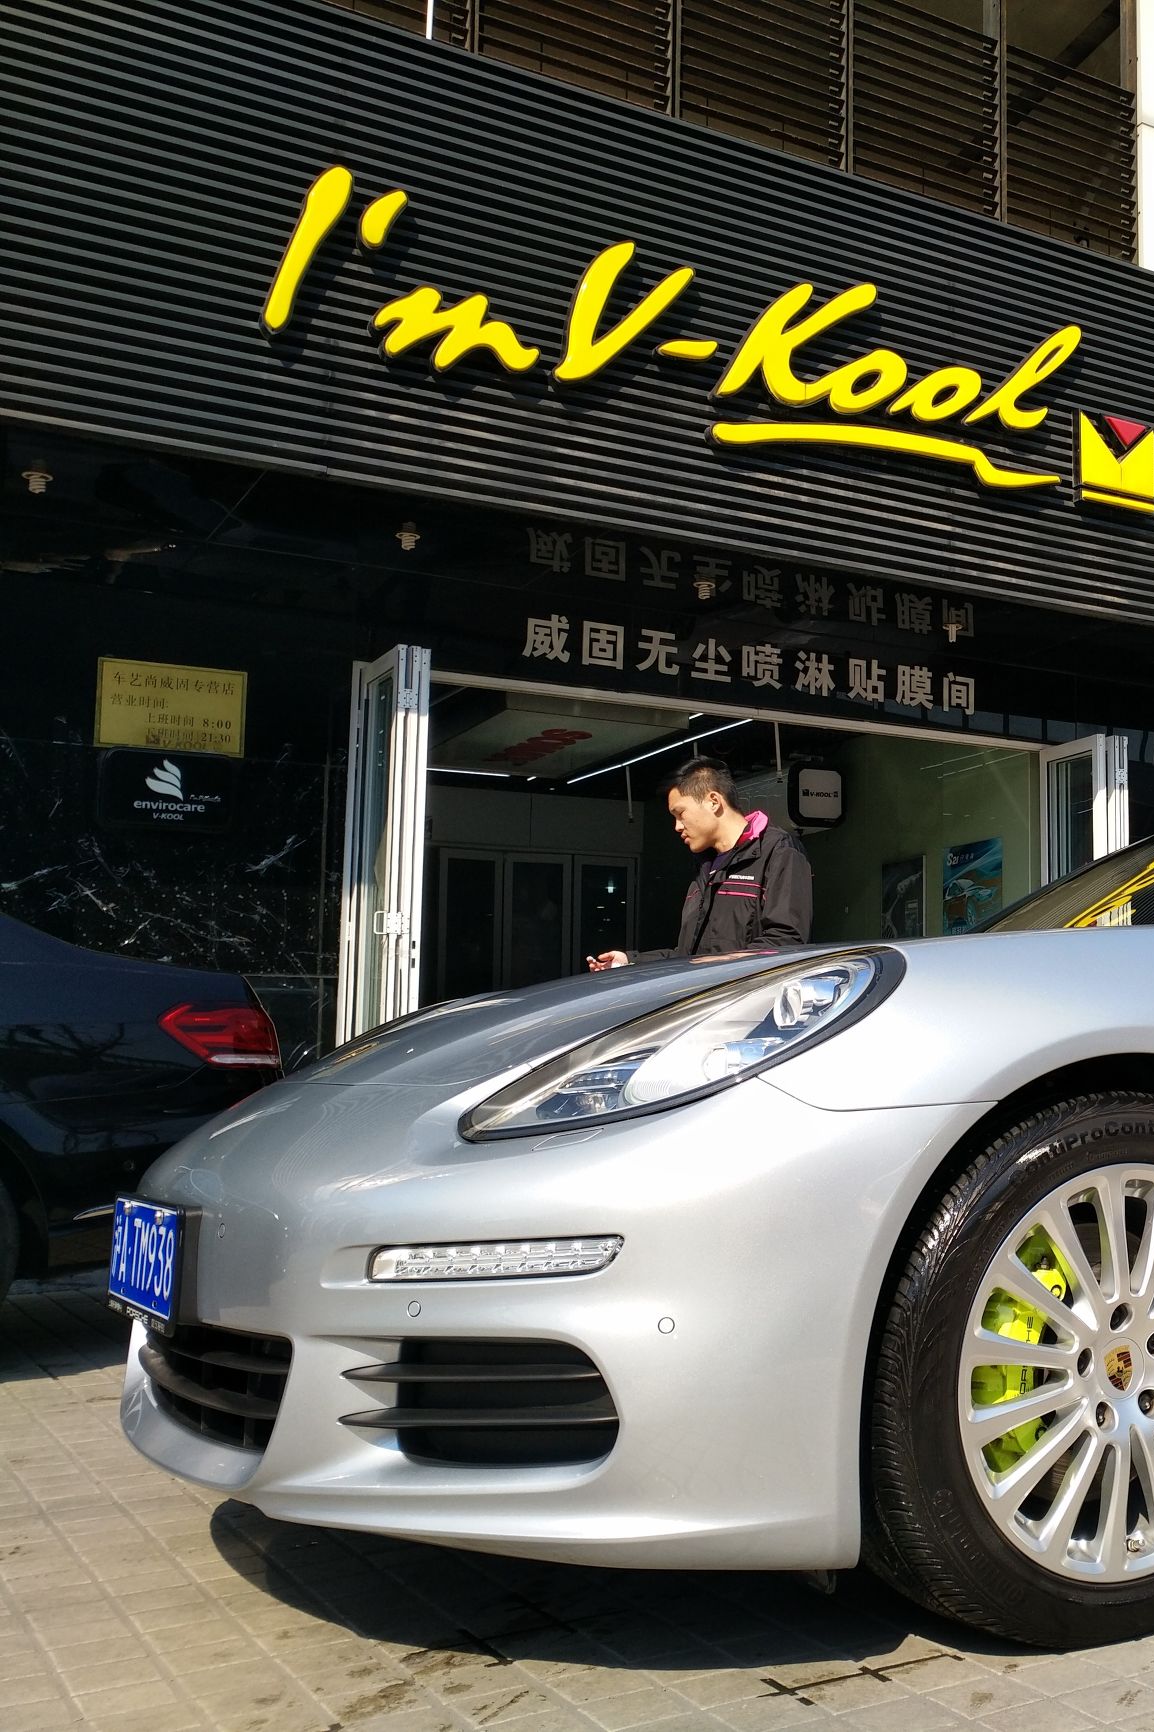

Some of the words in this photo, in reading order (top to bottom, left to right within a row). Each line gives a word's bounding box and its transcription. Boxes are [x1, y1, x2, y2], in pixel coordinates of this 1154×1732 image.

[262, 165, 540, 373] I'm
[554, 239, 1083, 432] V-Kool
[523, 614, 976, 716] 威固无尘喷淋贴膜间
[113, 671, 235, 696] 车艺尚威固专营店
[145, 712, 194, 728] 上班时间
[202, 719, 232, 730] 8:00
[201, 732, 231, 744] 21:30
[133, 800, 206, 813] envirocare
[153, 813, 184, 821] V-KOOL
